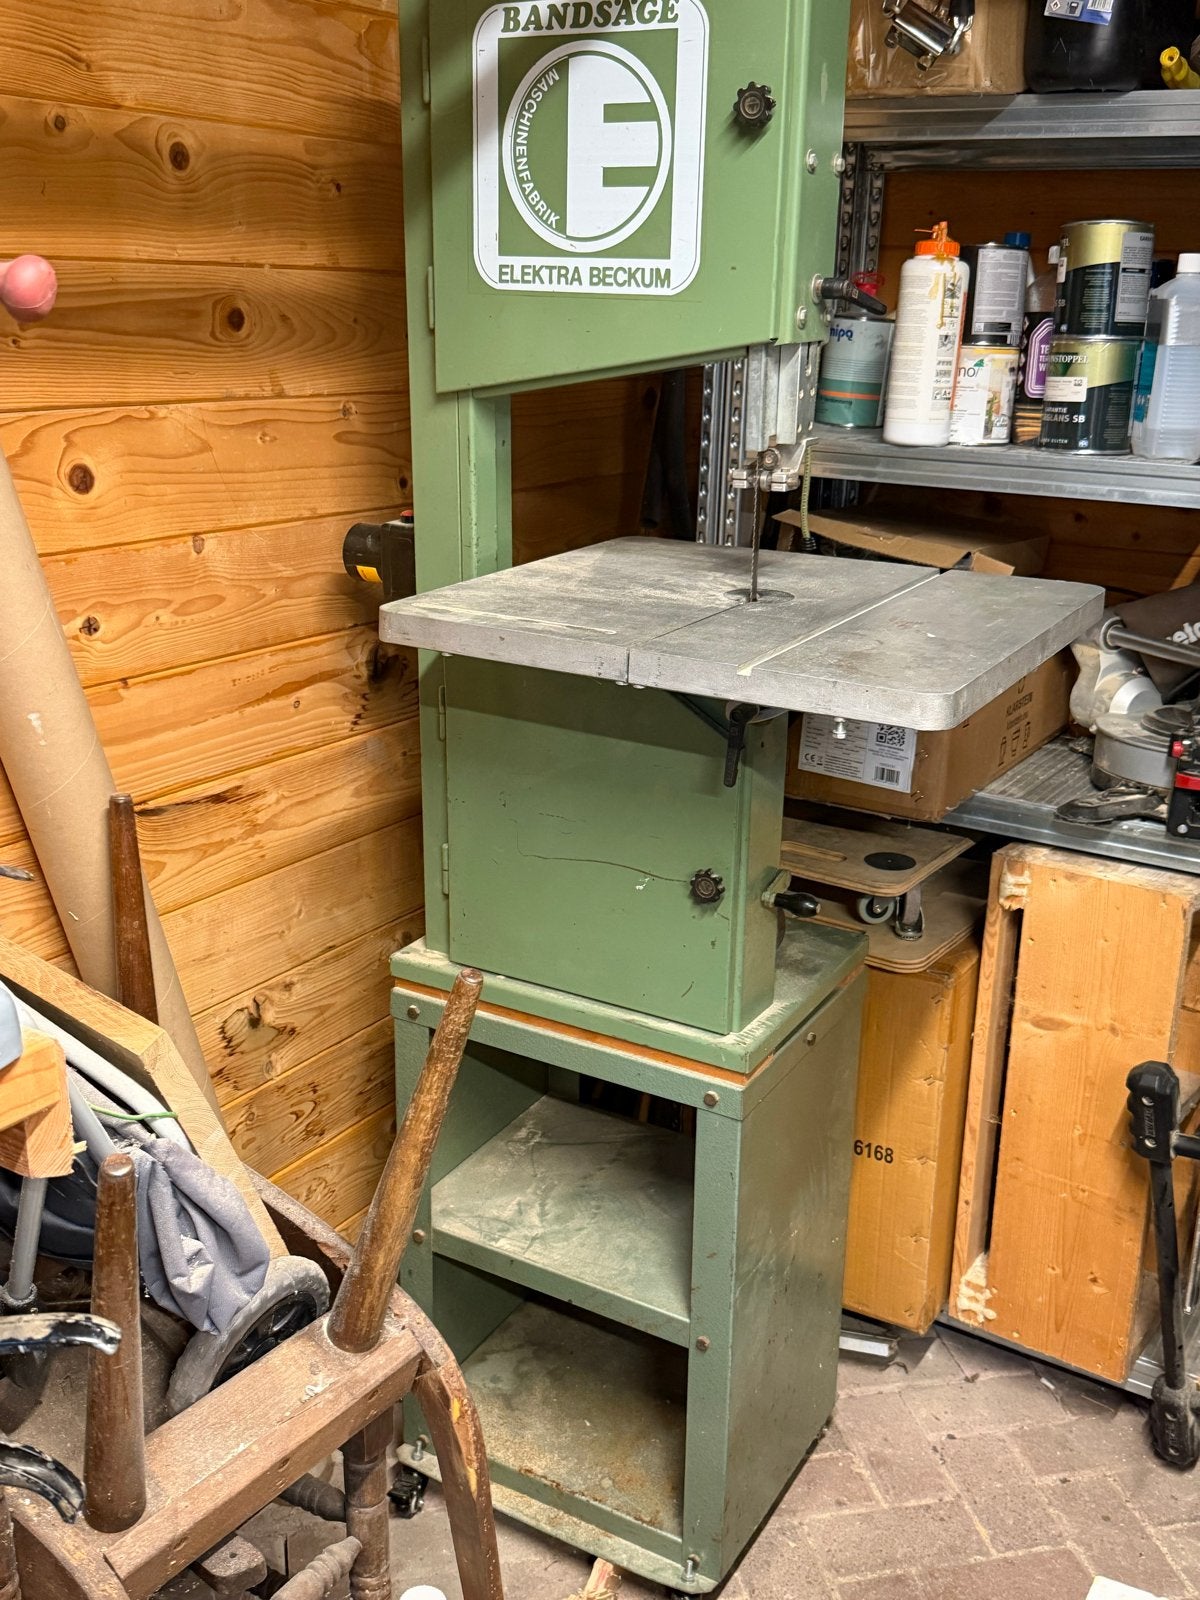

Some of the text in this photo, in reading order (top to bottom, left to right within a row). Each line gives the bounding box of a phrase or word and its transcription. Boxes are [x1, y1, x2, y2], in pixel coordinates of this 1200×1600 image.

[501, 0, 679, 33] BANDSÄGE
[516, 68, 560, 229] MASCHINENFABRIK
[498, 264, 671, 289] ELEKTRA BECKUM
[1072, 415, 1086, 424] SB
[1166, 621, 1200, 645] et
[853, 1139, 894, 1165] 6168
